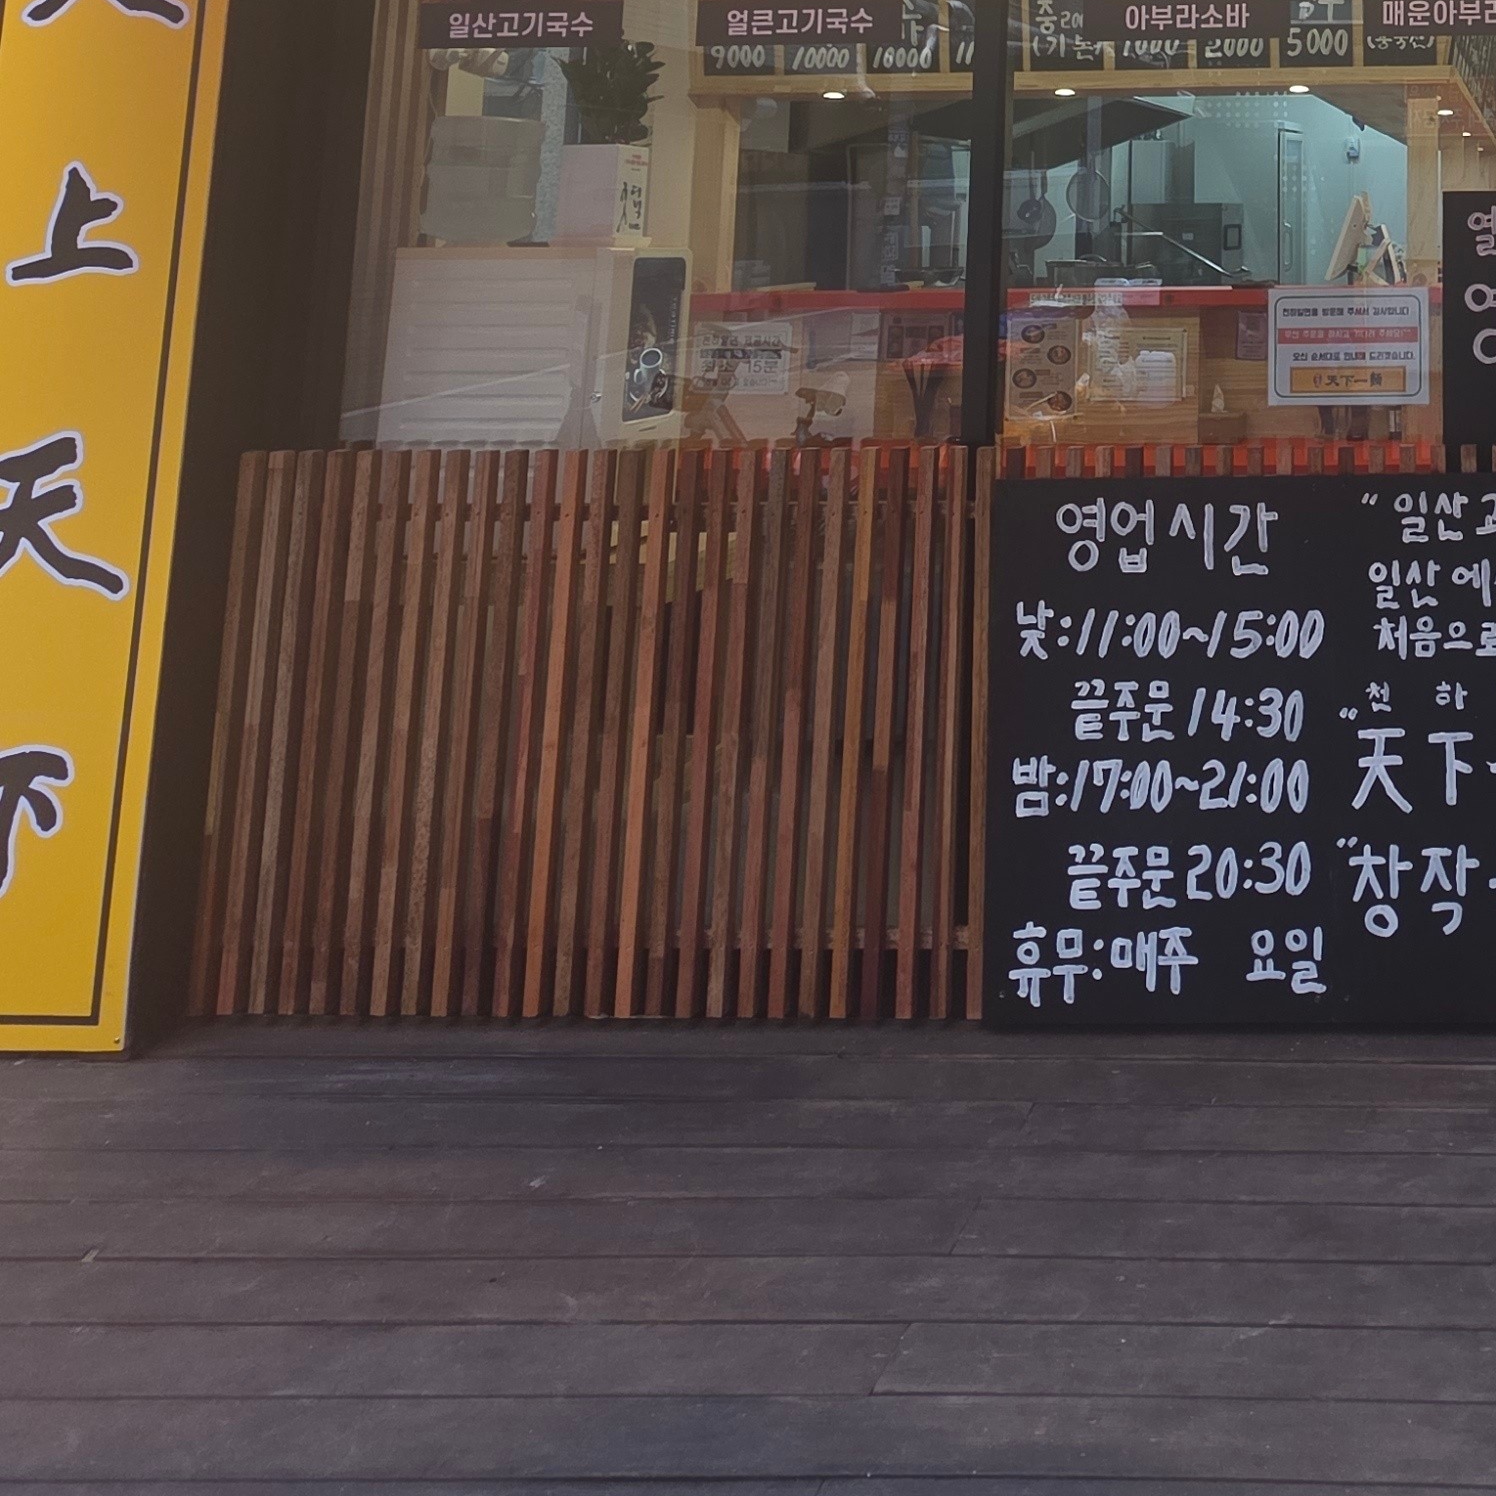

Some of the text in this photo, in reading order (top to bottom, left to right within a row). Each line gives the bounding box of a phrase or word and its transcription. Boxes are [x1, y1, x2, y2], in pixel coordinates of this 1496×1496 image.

[449, 12, 594, 39] 일산고기국수
[727, 8, 874, 36] 얼큰고기국수
[1125, 3, 1251, 30] 아부라소바
[1287, 27, 1349, 57] 5000
[711, 45, 766, 70] 9000
[792, 46, 850, 71] 10000
[1056, 497, 1279, 576] 영업시간
[1071, 679, 1305, 743] 끝주문 14:30
[1067, 841, 1311, 910] 끝주문 20:30
[1246, 926, 1327, 995] 요일
